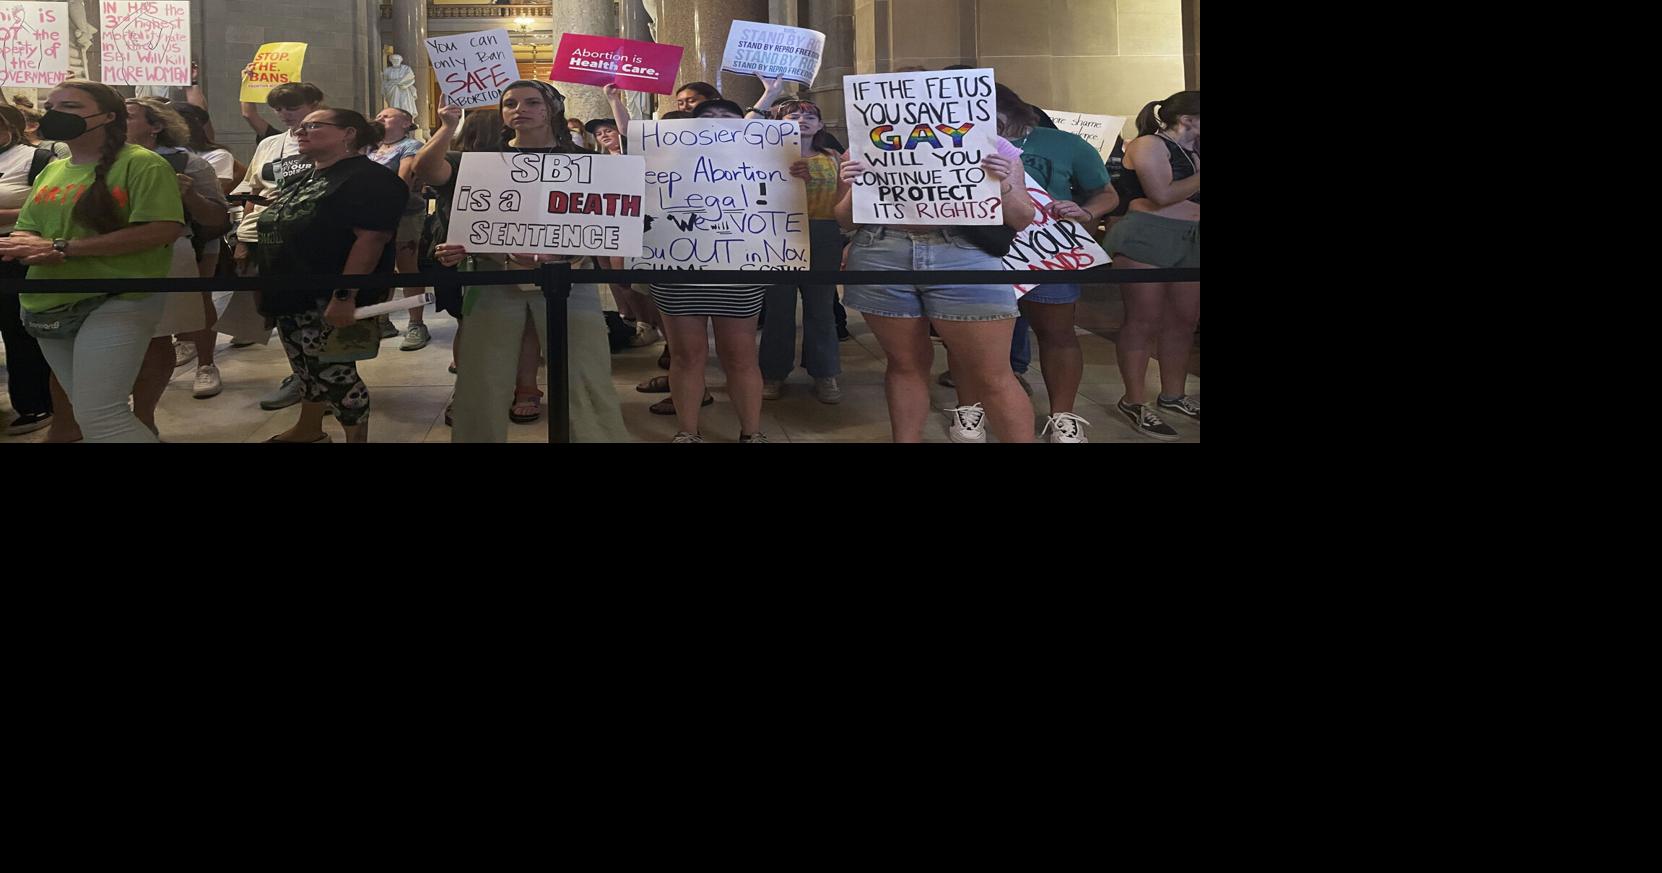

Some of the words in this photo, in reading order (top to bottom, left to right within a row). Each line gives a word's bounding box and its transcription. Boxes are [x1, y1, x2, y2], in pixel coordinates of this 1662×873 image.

[38, 8, 56, 23] is
[103, 2, 117, 14] IN
[165, 4, 185, 16] the
[0, 27, 20, 40] OT
[33, 29, 60, 40] the
[741, 28, 785, 45] STAND
[787, 33, 806, 49] BY
[0, 40, 38, 59] perty
[44, 42, 61, 59] of
[426, 40, 458, 53] You
[469, 34, 498, 48] can
[738, 40, 762, 50] STAND
[774, 46, 795, 54] REPRO
[796, 47, 820, 60] FREED
[10, 57, 36, 69] the
[255, 52, 290, 61] STOP.
[434, 56, 468, 71] only
[475, 51, 506, 63] Ban
[572, 48, 628, 63] Abortion
[632, 54, 643, 64] is
[735, 49, 780, 64] STAND
[780, 54, 799, 68] BY
[104, 66, 143, 83] MORE
[145, 66, 188, 83] WOMEN
[251, 62, 281, 72] THE.
[569, 57, 619, 71] Health
[621, 63, 660, 76] Care.
[732, 60, 757, 71] STAND
[758, 63, 769, 71] BY
[769, 64, 788, 73] REPRO
[0, 70, 66, 85] OVERNMENT
[445, 63, 511, 95] SAFE
[852, 81, 870, 100] IF
[874, 79, 916, 99] THE
[925, 75, 993, 99] FETUS
[447, 88, 504, 107] ABORTION
[853, 102, 900, 126] YOU
[903, 101, 961, 124] SAVE
[967, 99, 991, 122] IS
[1071, 113, 1102, 129] shame
[642, 122, 742, 150] Hoosier
[743, 121, 800, 149] GOP:
[869, 122, 976, 151] GAY
[864, 151, 924, 167] WILL
[932, 149, 981, 167] YOU
[510, 152, 592, 184] SB1
[644, 170, 683, 198] eep
[693, 155, 787, 184] Abortion
[950, 167, 986, 184] TO
[456, 186, 492, 212] is
[498, 189, 522, 212] a
[547, 190, 642, 218] DEATH
[878, 184, 978, 202] PROTECT
[916, 197, 1002, 220] RIGHTS?
[666, 212, 711, 232] We
[710, 220, 730, 231] will
[729, 211, 804, 236] VOTE
[469, 220, 620, 250] SENTENCE
[1014, 219, 1096, 260] YOUR
[631, 245, 666, 262] ou
[669, 237, 745, 264] OUT
[745, 253, 762, 263] in
[763, 238, 808, 264] Nov.
